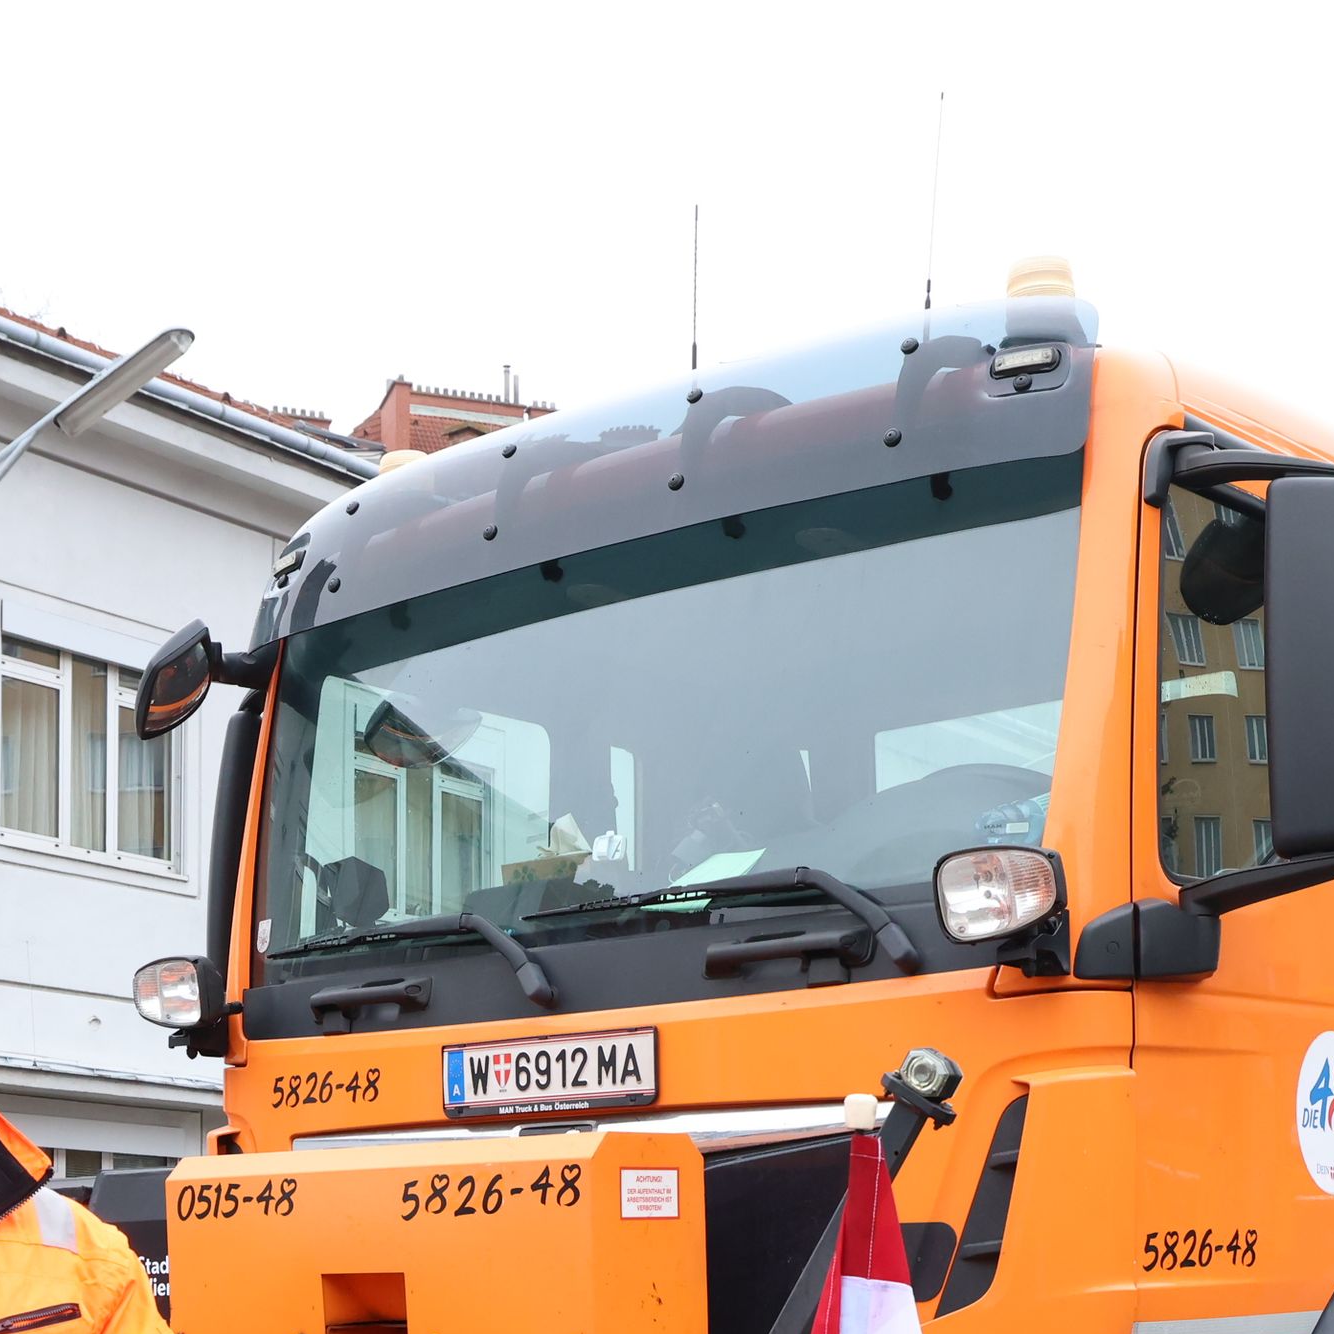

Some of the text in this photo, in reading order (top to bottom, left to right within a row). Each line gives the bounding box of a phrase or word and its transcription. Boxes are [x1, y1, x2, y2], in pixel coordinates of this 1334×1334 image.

[272, 1067, 381, 1109] 5826-48
[469, 1055, 490, 1096] W
[515, 1047, 588, 1092] 6912
[597, 1042, 642, 1086] MA
[499, 1101, 590, 1114] MAN Truck & Bus Österreich
[1302, 1107, 1319, 1129] DIE
[177, 1178, 298, 1222] 0515-48
[401, 1163, 582, 1222] 5826-48
[1142, 1228, 1258, 1272] 5826-48
